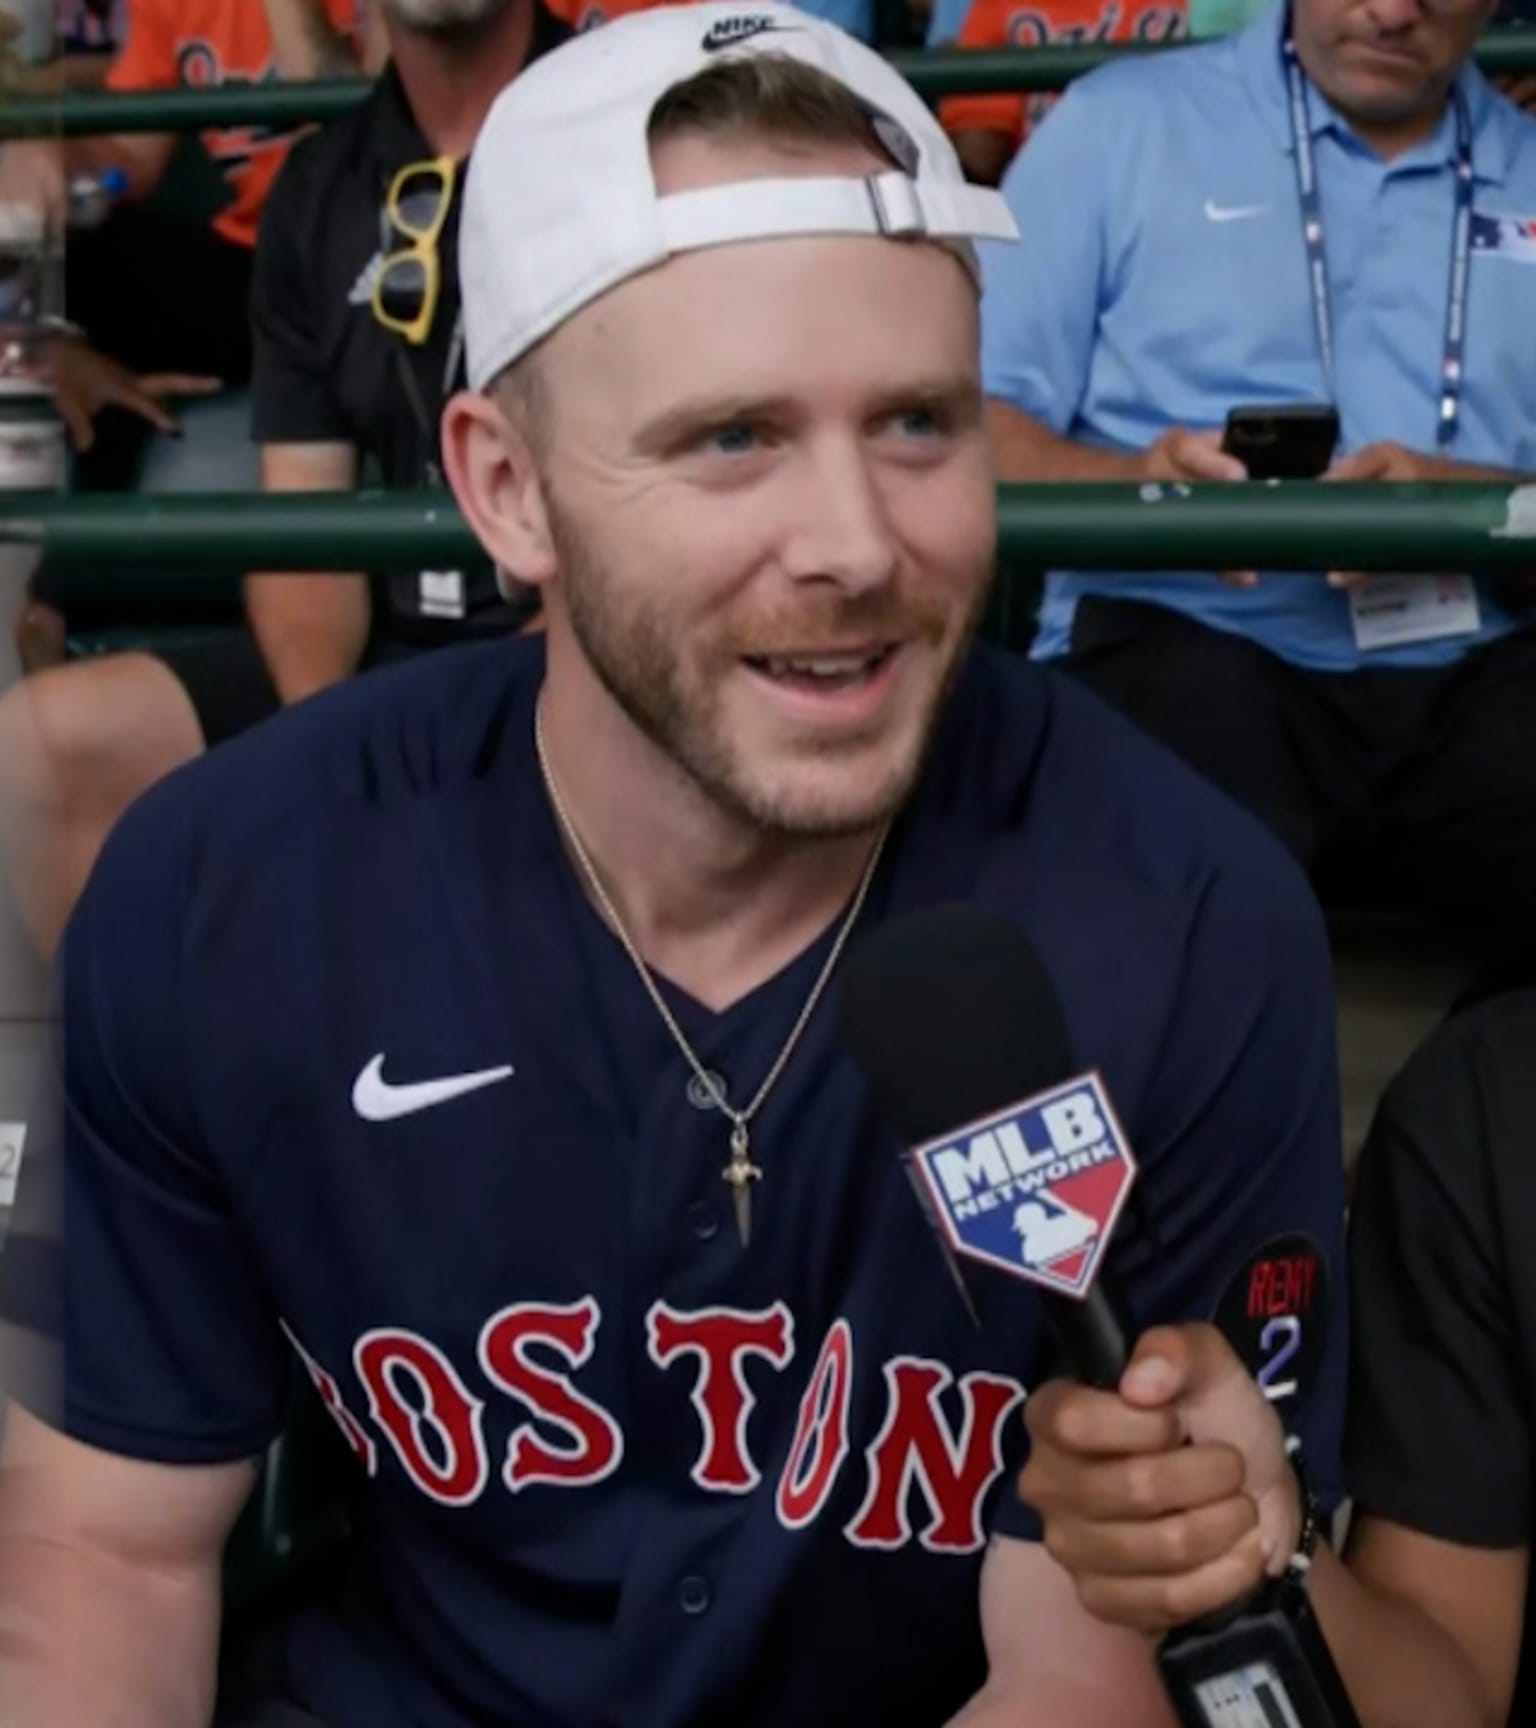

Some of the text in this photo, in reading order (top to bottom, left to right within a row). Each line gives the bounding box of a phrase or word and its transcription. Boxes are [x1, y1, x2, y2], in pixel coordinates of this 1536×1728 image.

[712, 13, 775, 35] NIKE
[931, 1089, 1107, 1203] MLB
[951, 1139, 1116, 1224] NETWORK
[1257, 1313, 1302, 1400] 2
[277, 1294, 1028, 1555] OSTON
